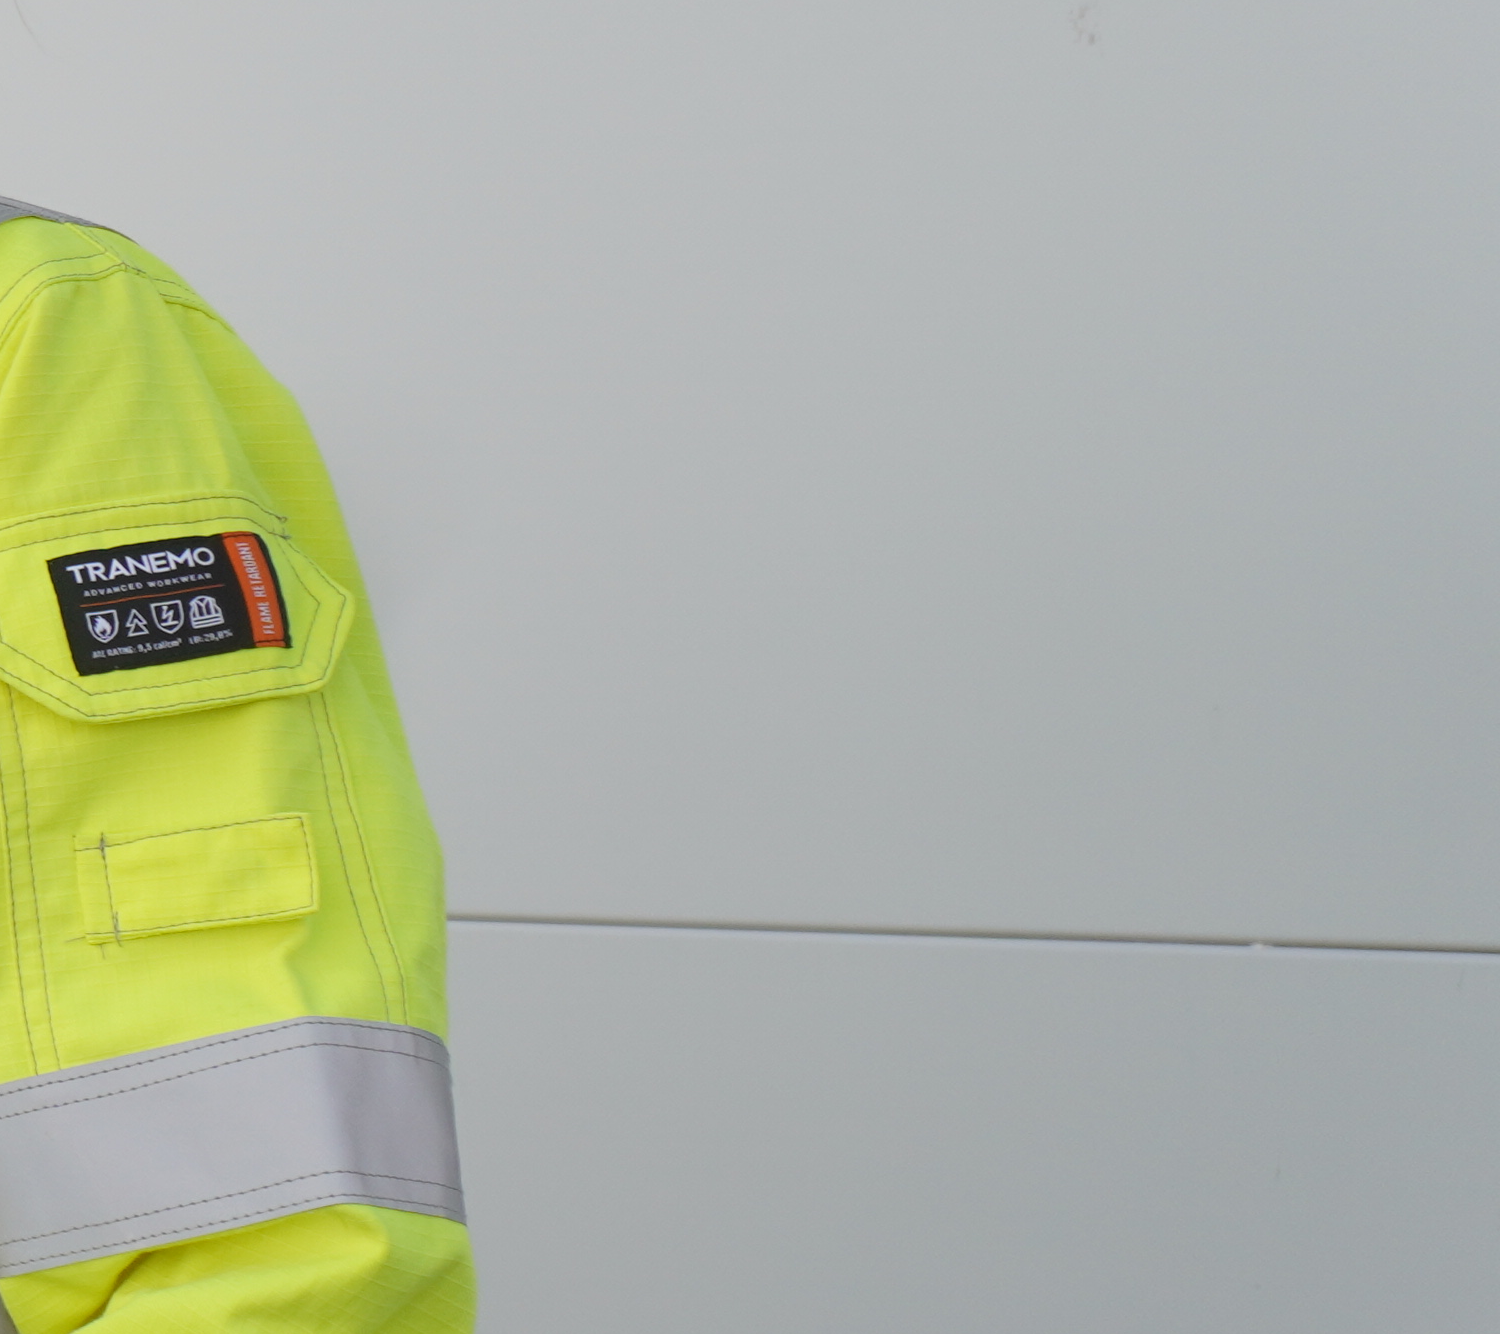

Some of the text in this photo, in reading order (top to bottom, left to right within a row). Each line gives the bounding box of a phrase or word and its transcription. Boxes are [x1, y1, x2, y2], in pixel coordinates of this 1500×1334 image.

[66, 547, 215, 583] TRANEMO
[83, 572, 213, 597] ADVANCED WORKWEAR
[235, 542, 275, 635] FLAME RETARDANT
